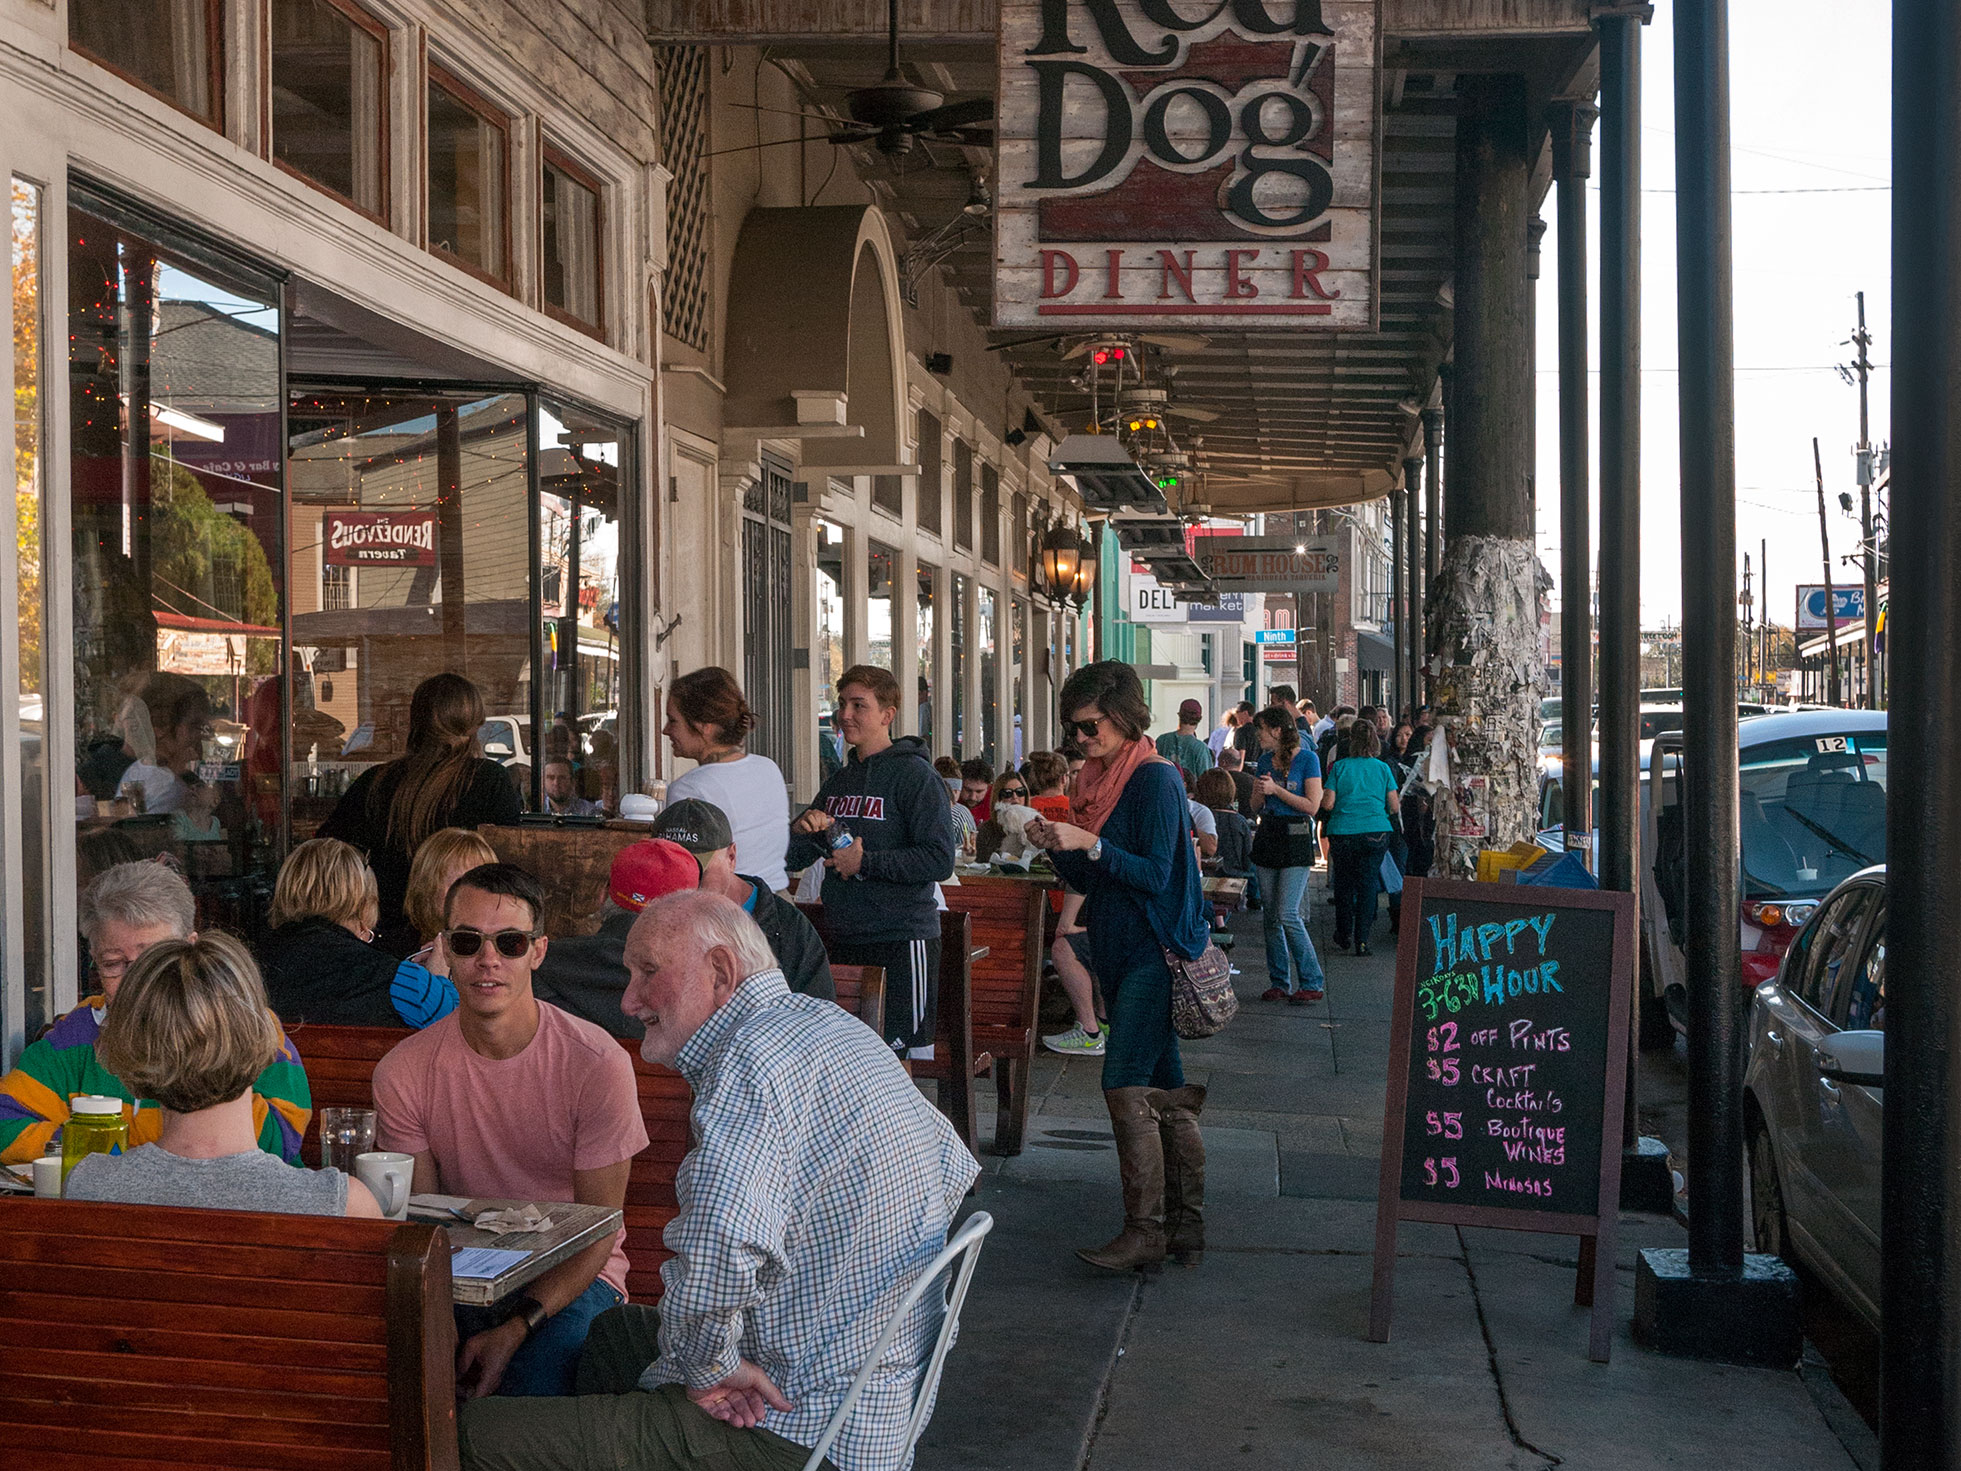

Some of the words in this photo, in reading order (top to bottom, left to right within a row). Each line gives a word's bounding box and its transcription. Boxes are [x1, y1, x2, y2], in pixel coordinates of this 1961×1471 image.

[1024, 42, 1333, 227] Dog
[1038, 249, 1341, 303] DINER
[1212, 555, 1257, 575] RUM
[1262, 553, 1327, 574] HOUSE
[1263, 631, 1287, 642] Ninth
[1820, 738, 1846, 752] 12
[1427, 912, 1557, 975] HAPPY
[1481, 960, 1564, 1007] HOUR
[1426, 1021, 1461, 1053] $2
[1426, 1057, 1460, 1087] $5
[1471, 1063, 1536, 1088] CRAFT
[1425, 1110, 1463, 1141] $5
[1422, 1156, 1461, 1190] $5
